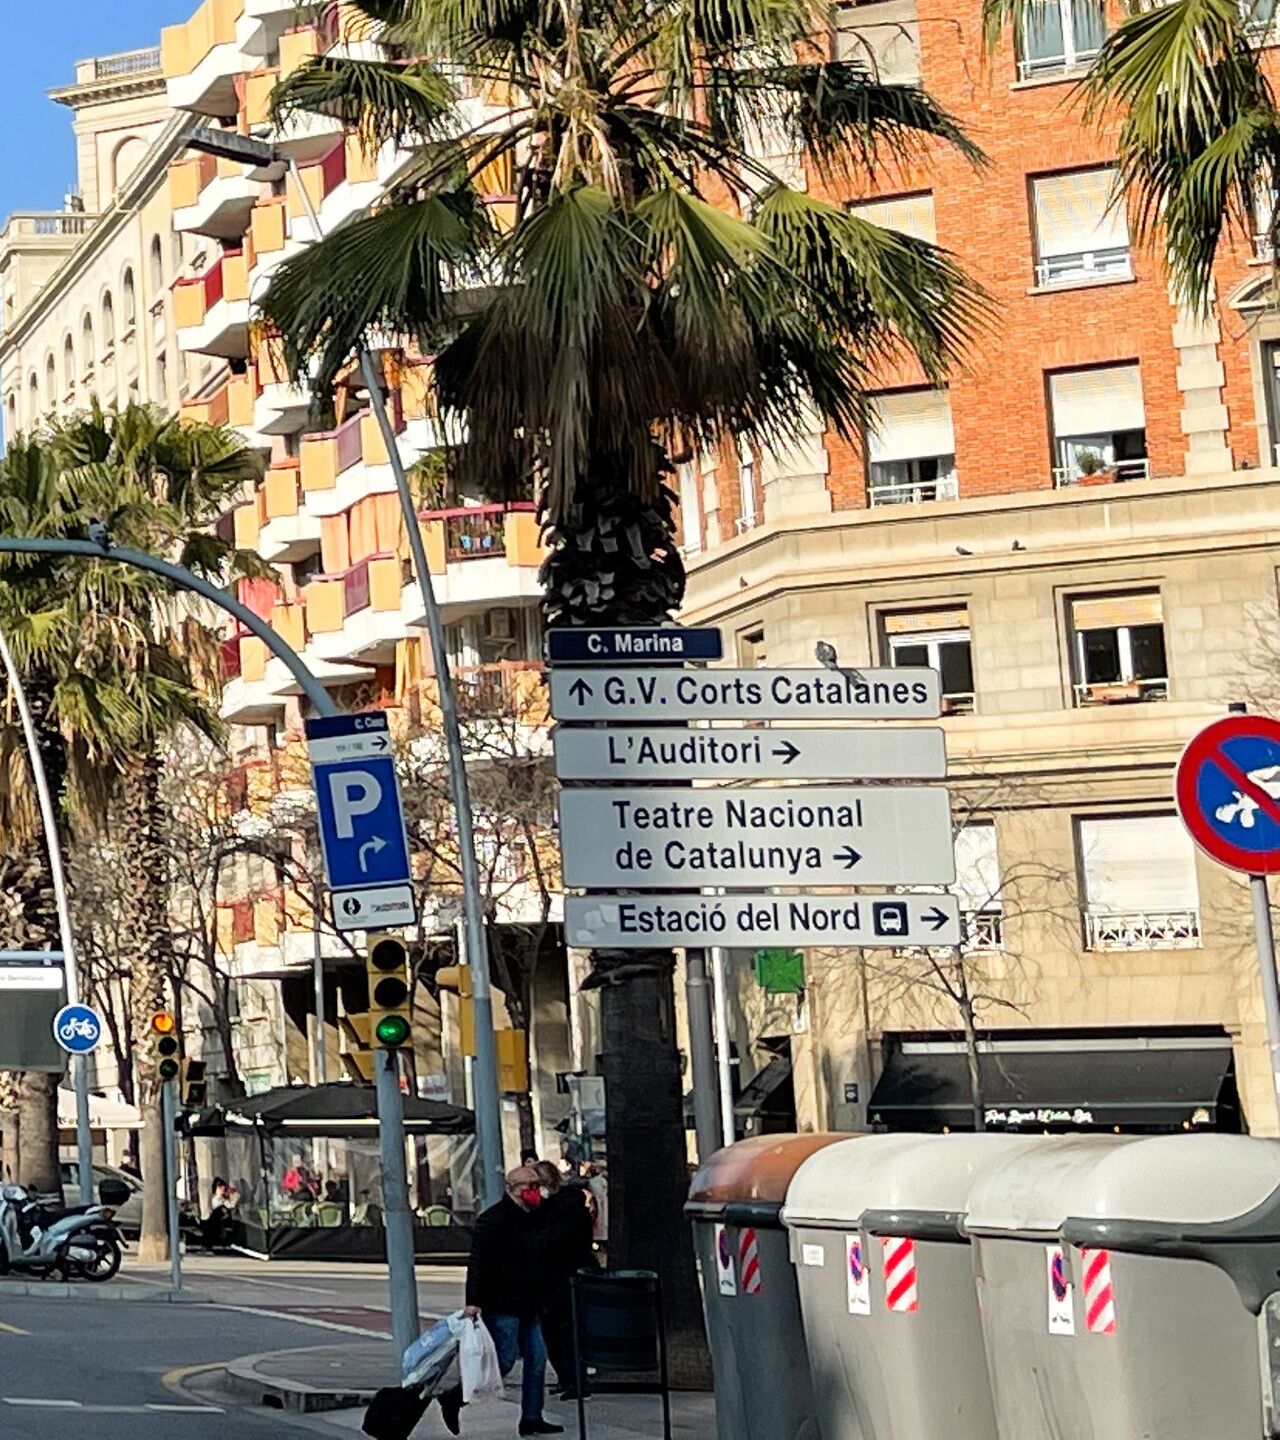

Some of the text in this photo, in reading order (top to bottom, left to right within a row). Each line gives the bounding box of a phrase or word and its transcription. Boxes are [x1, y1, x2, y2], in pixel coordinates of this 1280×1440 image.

[587, 633, 683, 653] C. Marina
[604, 675, 928, 705] G.V. Corts Catalanes
[608, 735, 761, 764] L'Auditori
[328, 769, 382, 839] P
[612, 799, 863, 829] Teatre Nacional
[615, 840, 822, 875] de Catalunya
[618, 902, 860, 932] Estació del Nord
